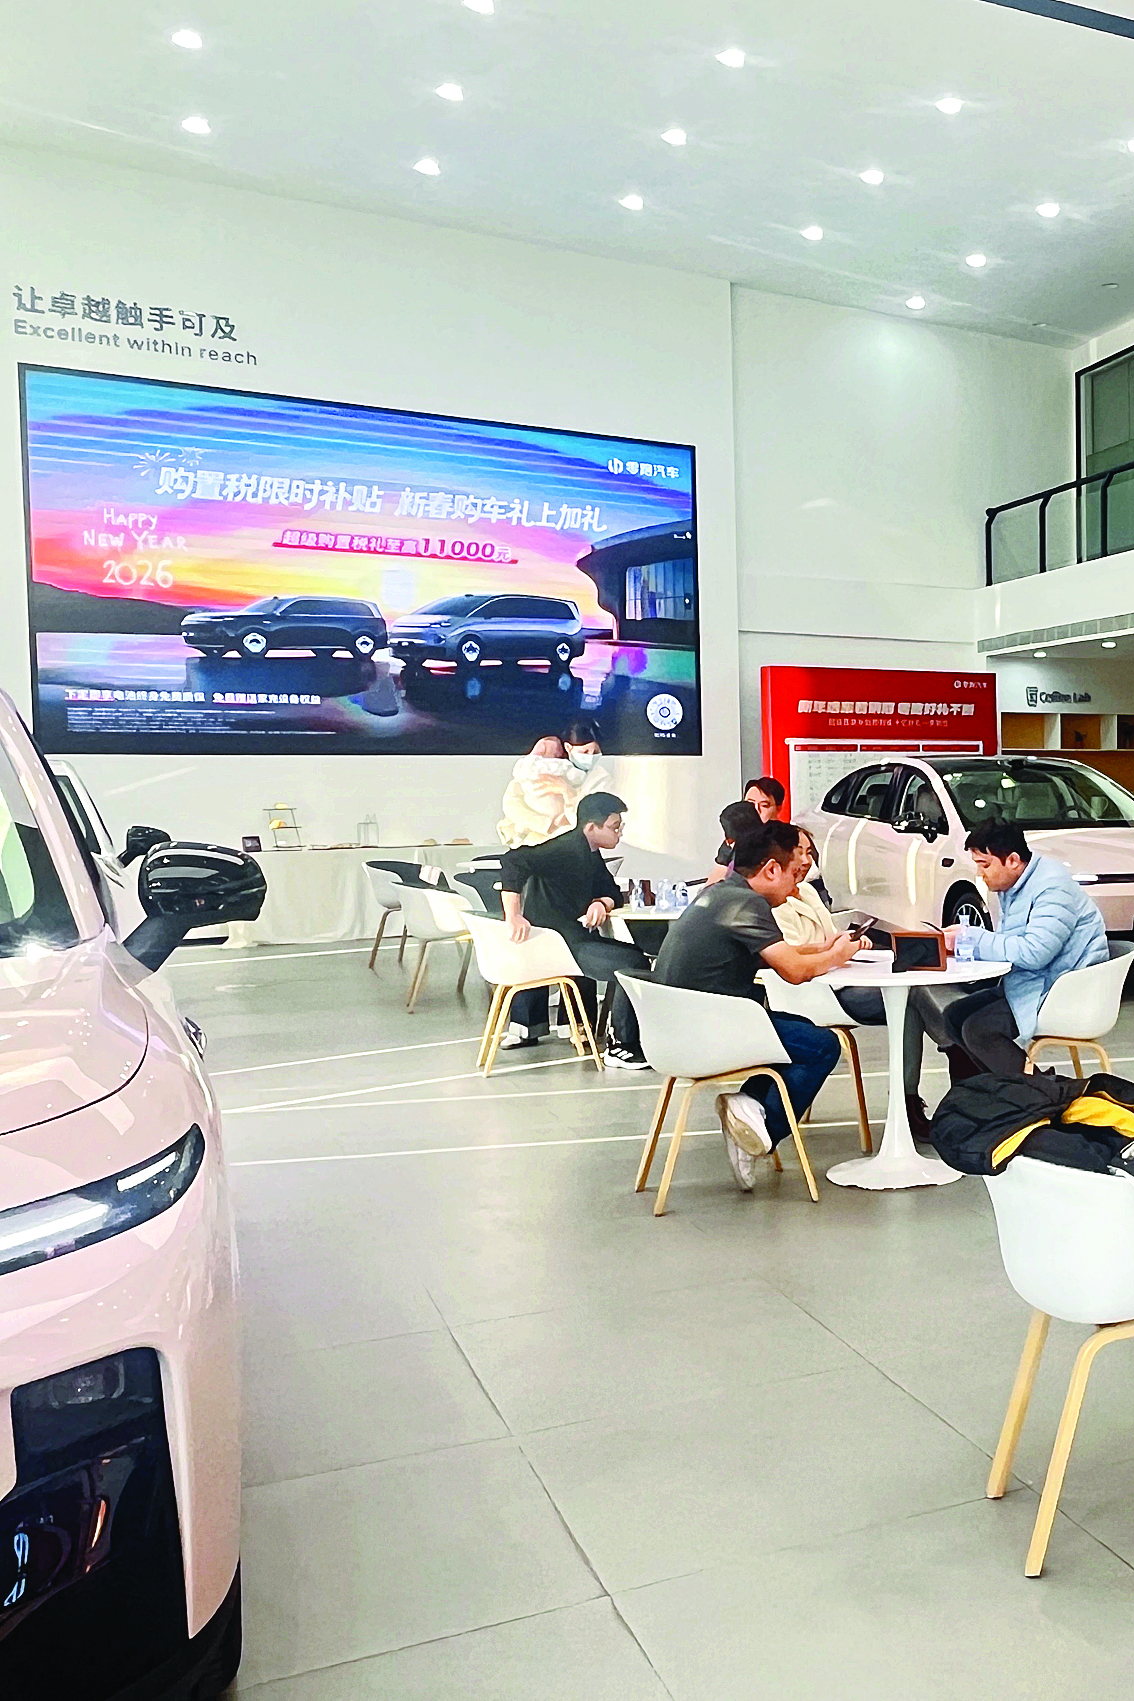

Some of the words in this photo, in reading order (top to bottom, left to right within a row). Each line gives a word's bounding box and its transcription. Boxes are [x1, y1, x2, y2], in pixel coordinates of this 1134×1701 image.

[13, 285, 237, 342] 让卓越触手可及
[13, 319, 121, 347] Excellent
[127, 337, 192, 357] within
[200, 348, 258, 366] reach
[155, 466, 385, 514] 购置税限时补贴
[394, 486, 608, 532] 新春购车礼上加礼
[102, 560, 174, 588] 2026
